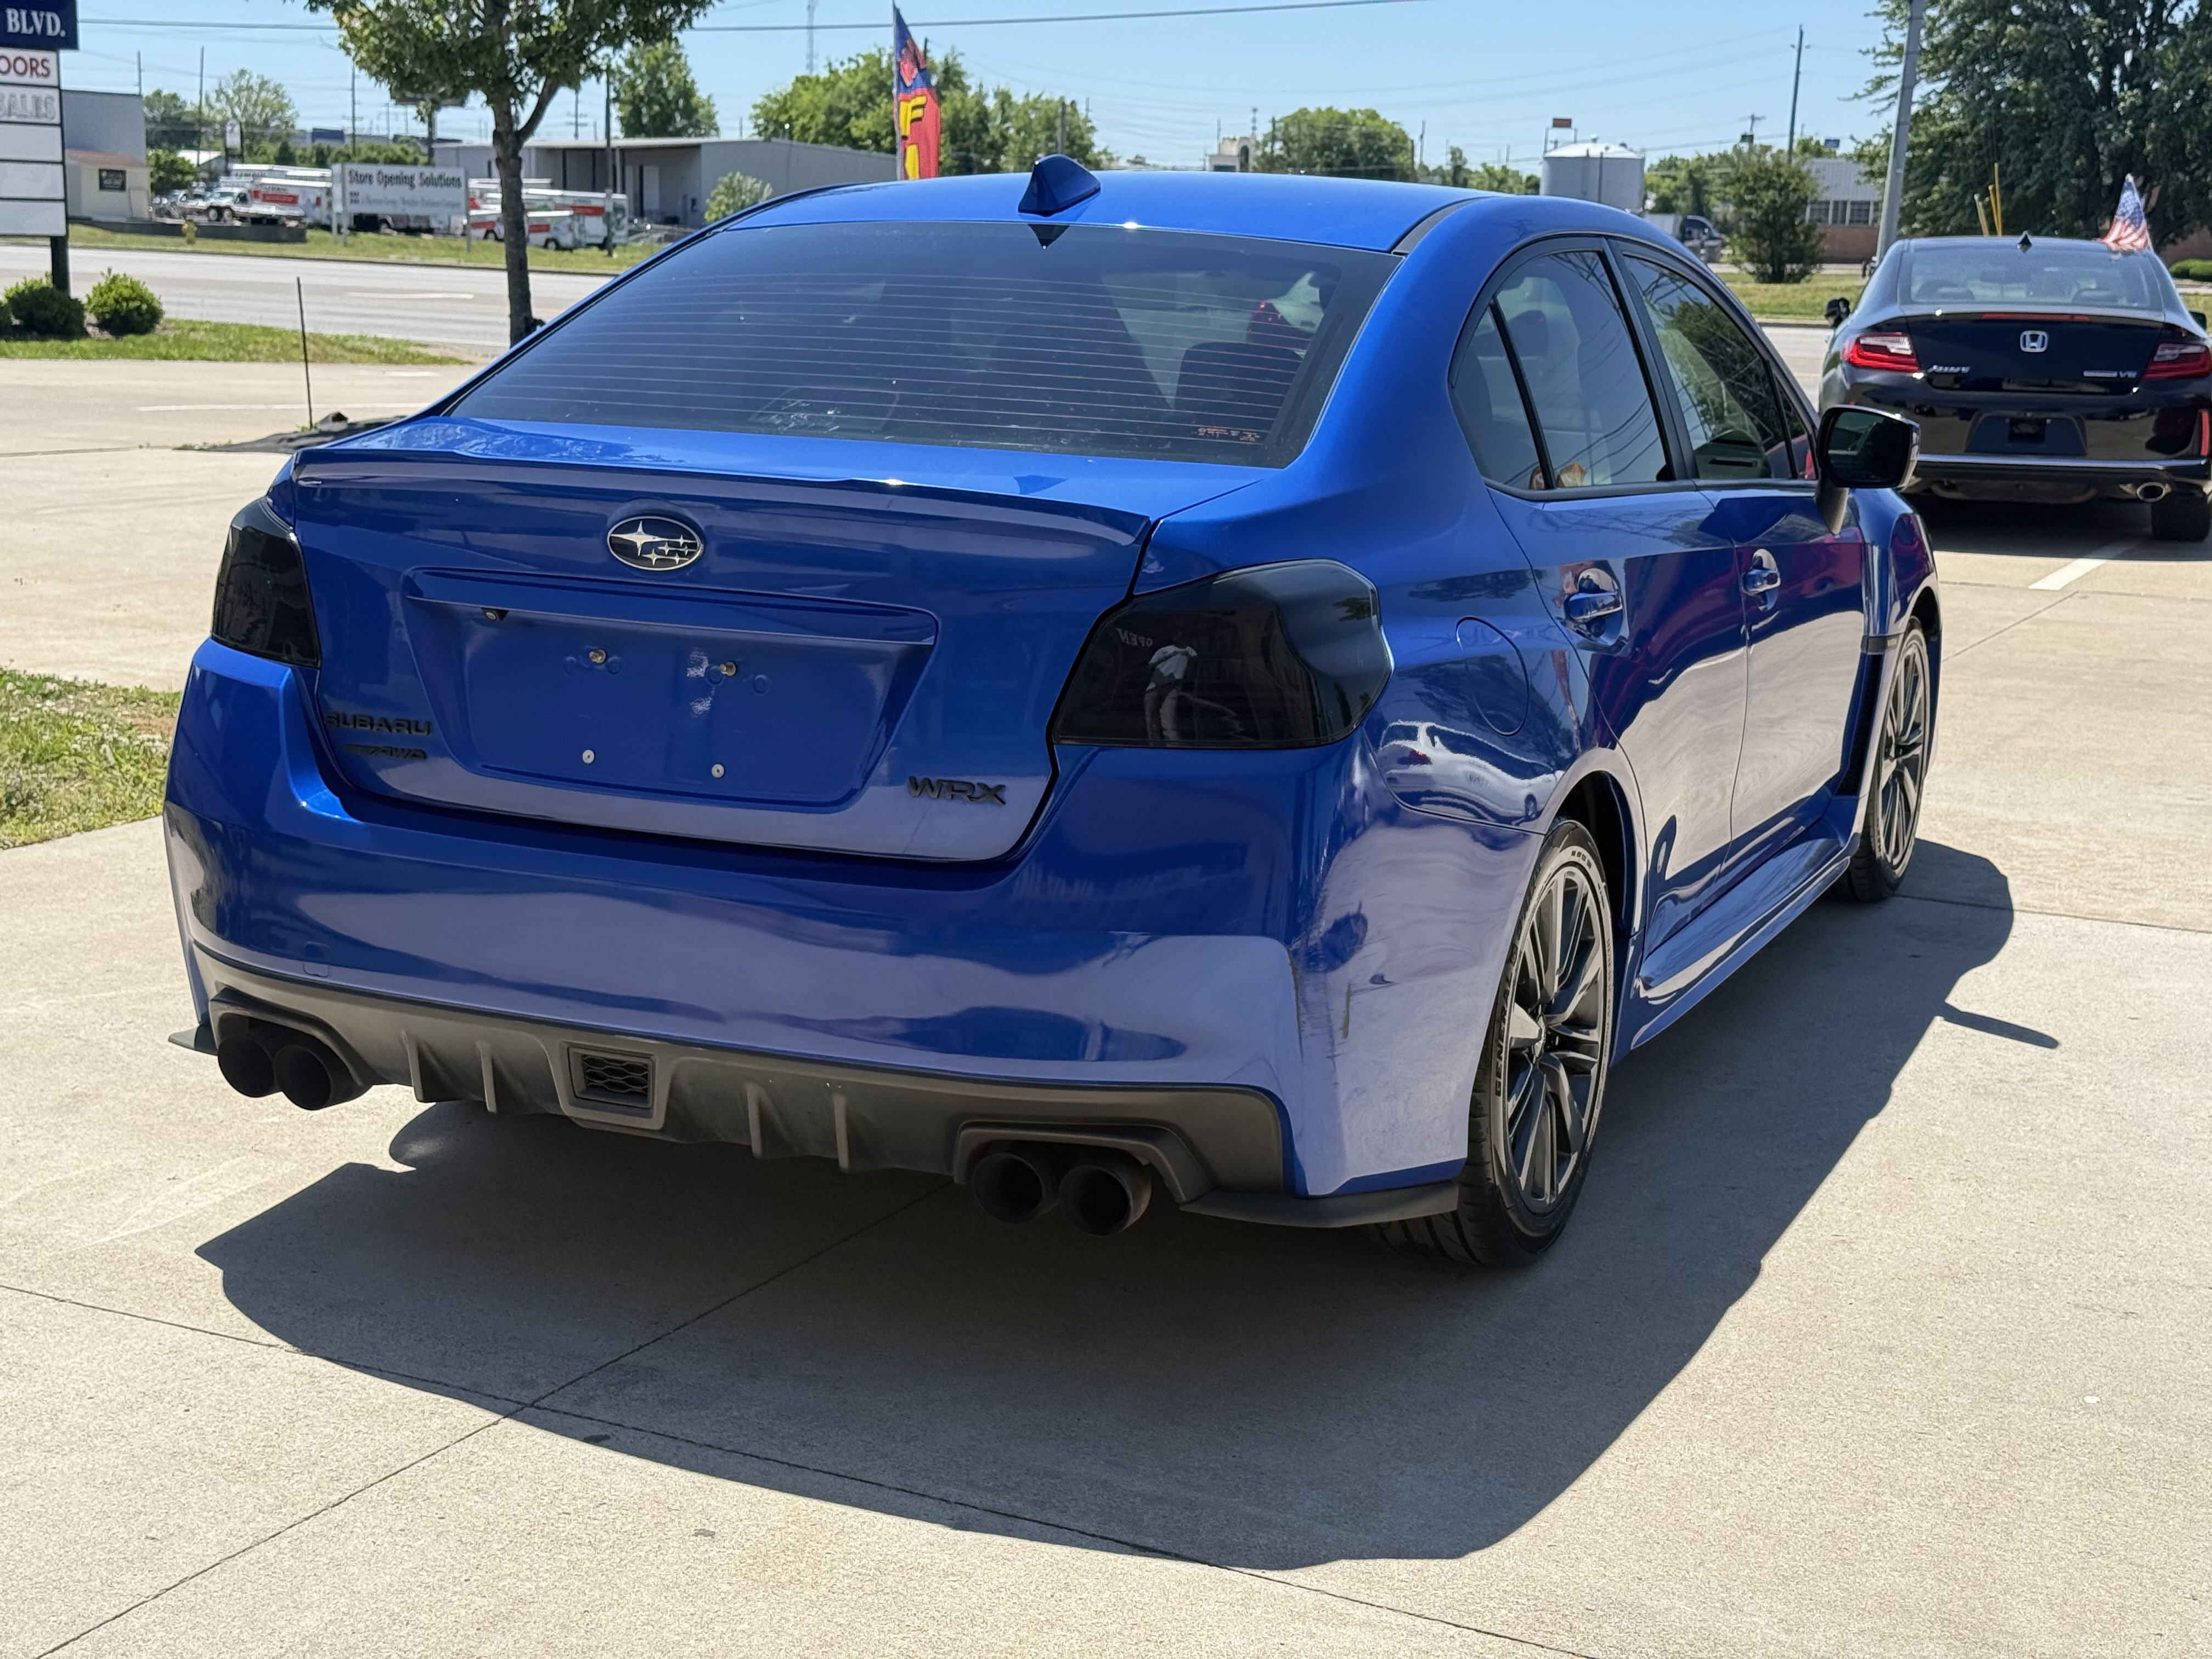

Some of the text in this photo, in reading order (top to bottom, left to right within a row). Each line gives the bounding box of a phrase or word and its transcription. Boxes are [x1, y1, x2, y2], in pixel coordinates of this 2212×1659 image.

[5, 7, 66, 38] BLVD.
[348, 169, 462, 190] Store Opening Solutions
[326, 713, 432, 736] SUBARU
[908, 776, 1006, 805] WRX
